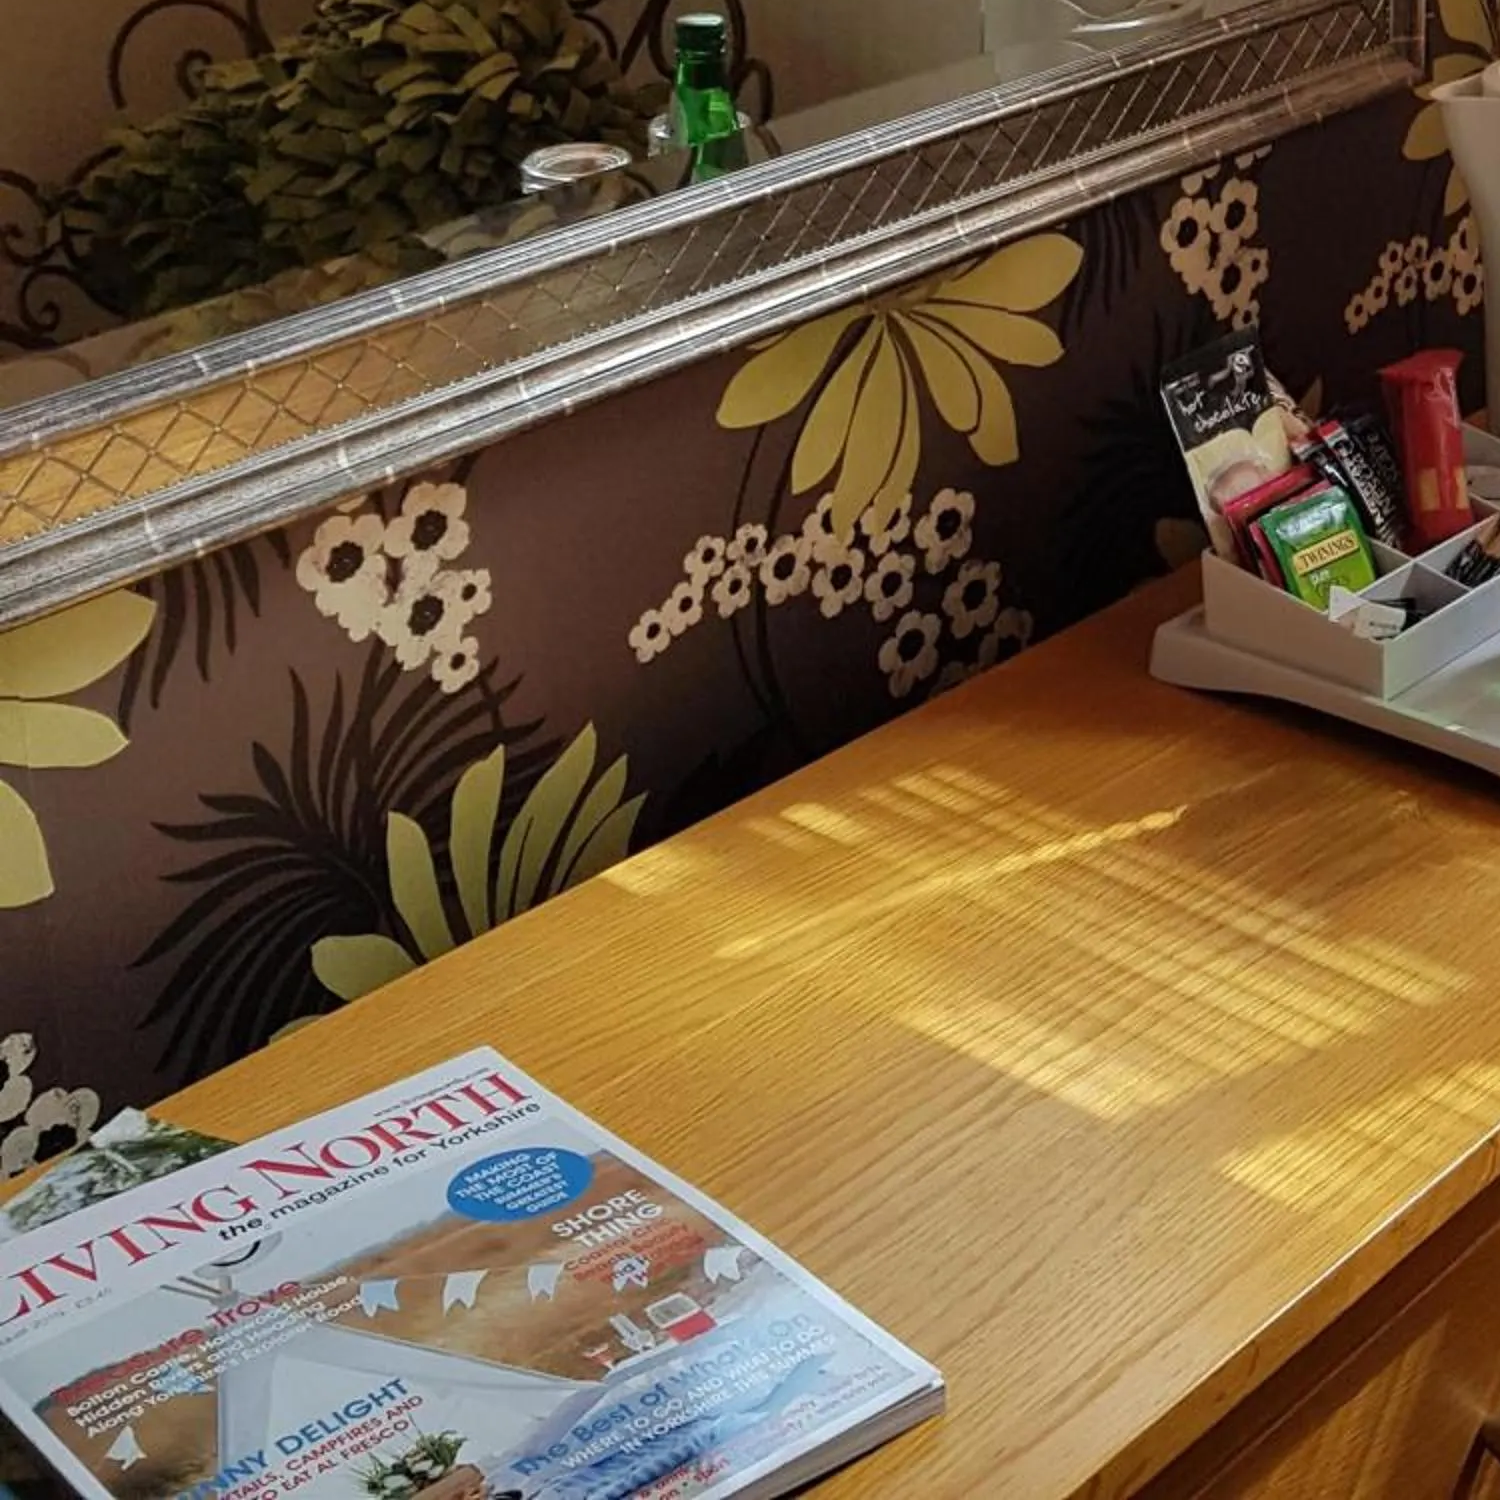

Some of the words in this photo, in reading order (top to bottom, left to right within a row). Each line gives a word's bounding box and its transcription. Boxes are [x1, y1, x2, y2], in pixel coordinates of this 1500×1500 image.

[239, 1071, 532, 1200] NORTH
[218, 1217, 262, 1241] the
[270, 1165, 389, 1219] magazine
[392, 1149, 428, 1167] for
[429, 1102, 541, 1151] Yorkshire
[551, 1189, 647, 1237] SHORE
[572, 1203, 663, 1248] THING
[206, 1280, 301, 1329] Trove
[66, 1382, 129, 1417] Bolton
[75, 1388, 147, 1427] Hidden
[87, 1405, 145, 1438] Along
[275, 1377, 409, 1455] DELIGHT
[559, 1430, 625, 1469] WHERE
[625, 1416, 649, 1434] TO
[653, 1398, 683, 1418] GO
[688, 1377, 723, 1400] AND
[571, 1403, 635, 1442] Best
[280, 1470, 315, 1491] EAT
[317, 1457, 338, 1475] AL
[340, 1419, 409, 1461] FRESCO
[285, 1416, 382, 1472] CAMPFIRES
[385, 1395, 424, 1420] AND
[619, 1434, 641, 1454] IN
